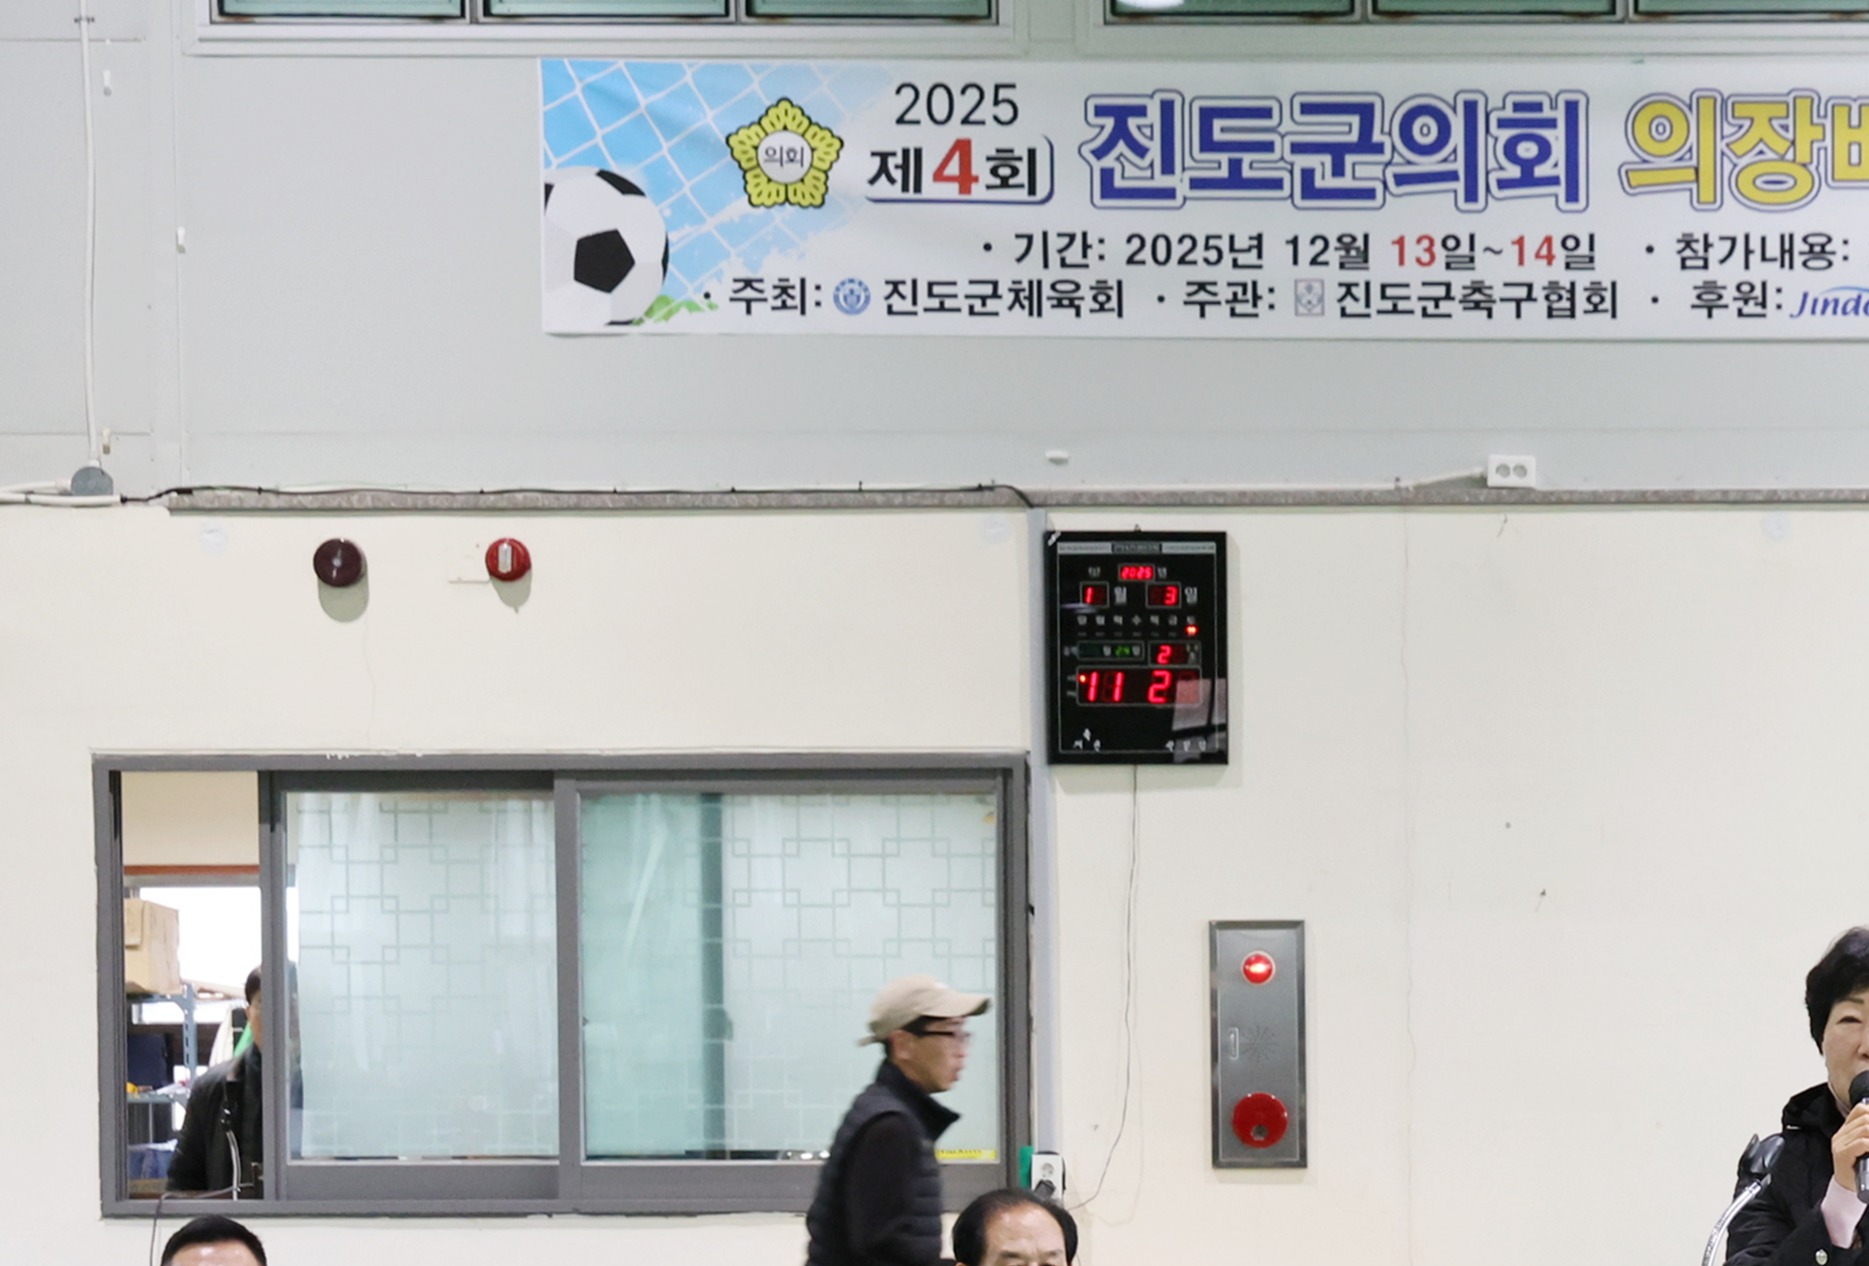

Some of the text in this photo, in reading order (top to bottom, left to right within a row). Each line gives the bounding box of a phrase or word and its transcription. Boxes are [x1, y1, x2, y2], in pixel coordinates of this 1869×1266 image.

[896, 83, 1020, 127] 2025
[763, 145, 806, 168] 의회
[867, 138, 1039, 196] 제4회
[1082, 92, 1587, 209] 진도군의회
[1013, 231, 1106, 270] 기간:
[1126, 232, 1265, 270] 2025년
[1286, 233, 1372, 270] 12월
[1392, 233, 1598, 272] 13일~14일
[1676, 233, 1850, 272] 참가내용:
[729, 278, 823, 317] 주최:
[884, 278, 1125, 319] 진도군체육회
[1183, 280, 1276, 320] 주관:
[1337, 280, 1619, 320] 진도군축구협회
[1691, 280, 1783, 320] 후원:
